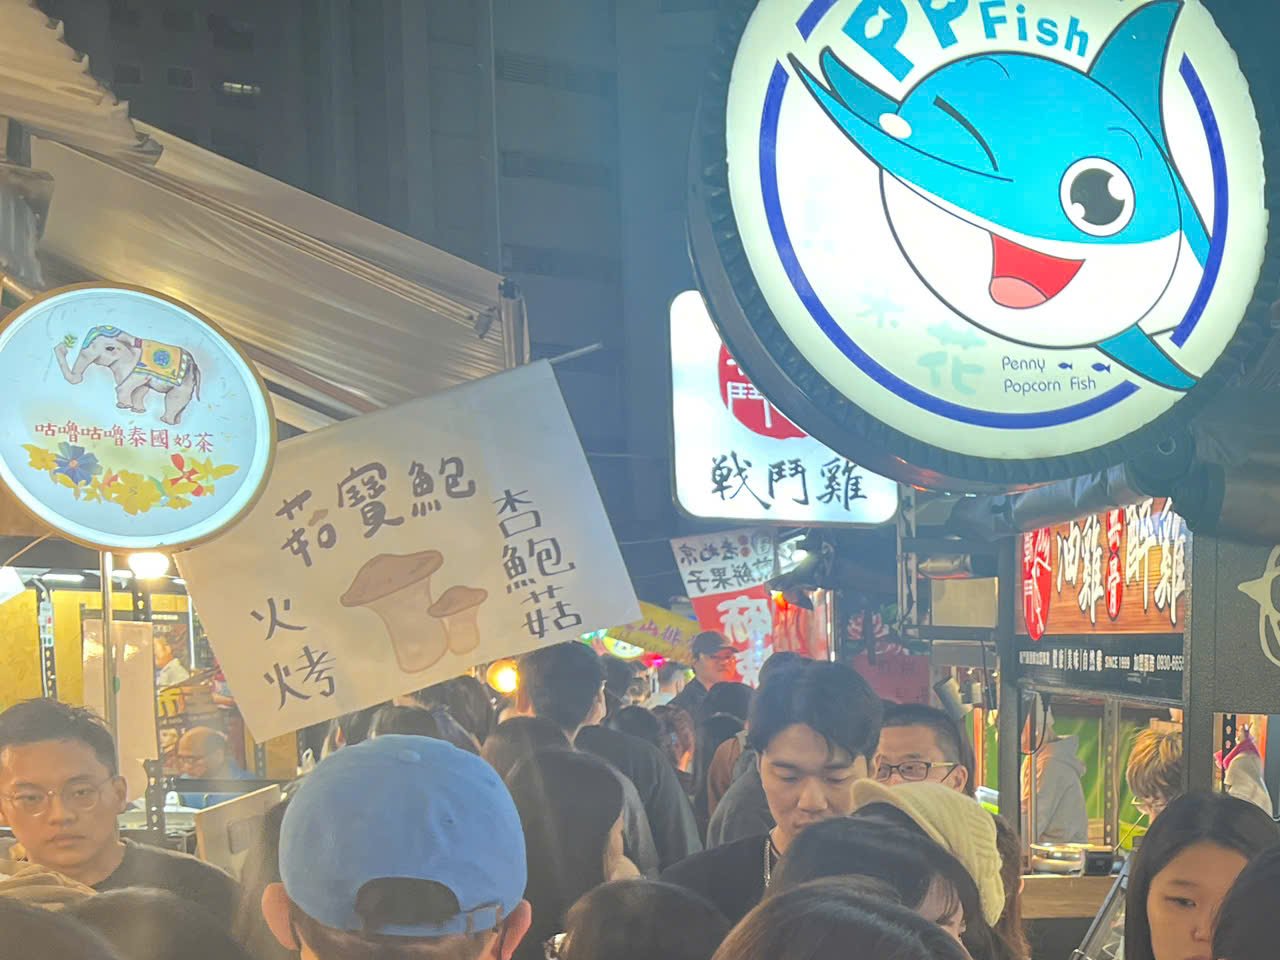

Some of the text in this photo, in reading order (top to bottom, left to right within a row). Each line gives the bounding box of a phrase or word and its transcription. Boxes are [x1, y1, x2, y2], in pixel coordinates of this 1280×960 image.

[979, 1, 1090, 57] Fish
[1002, 356, 1046, 373] Penny
[1004, 378, 1061, 396] Popcorn
[492, 489, 582, 638] 杏鮑菇
[250, 597, 336, 711] 火烤
